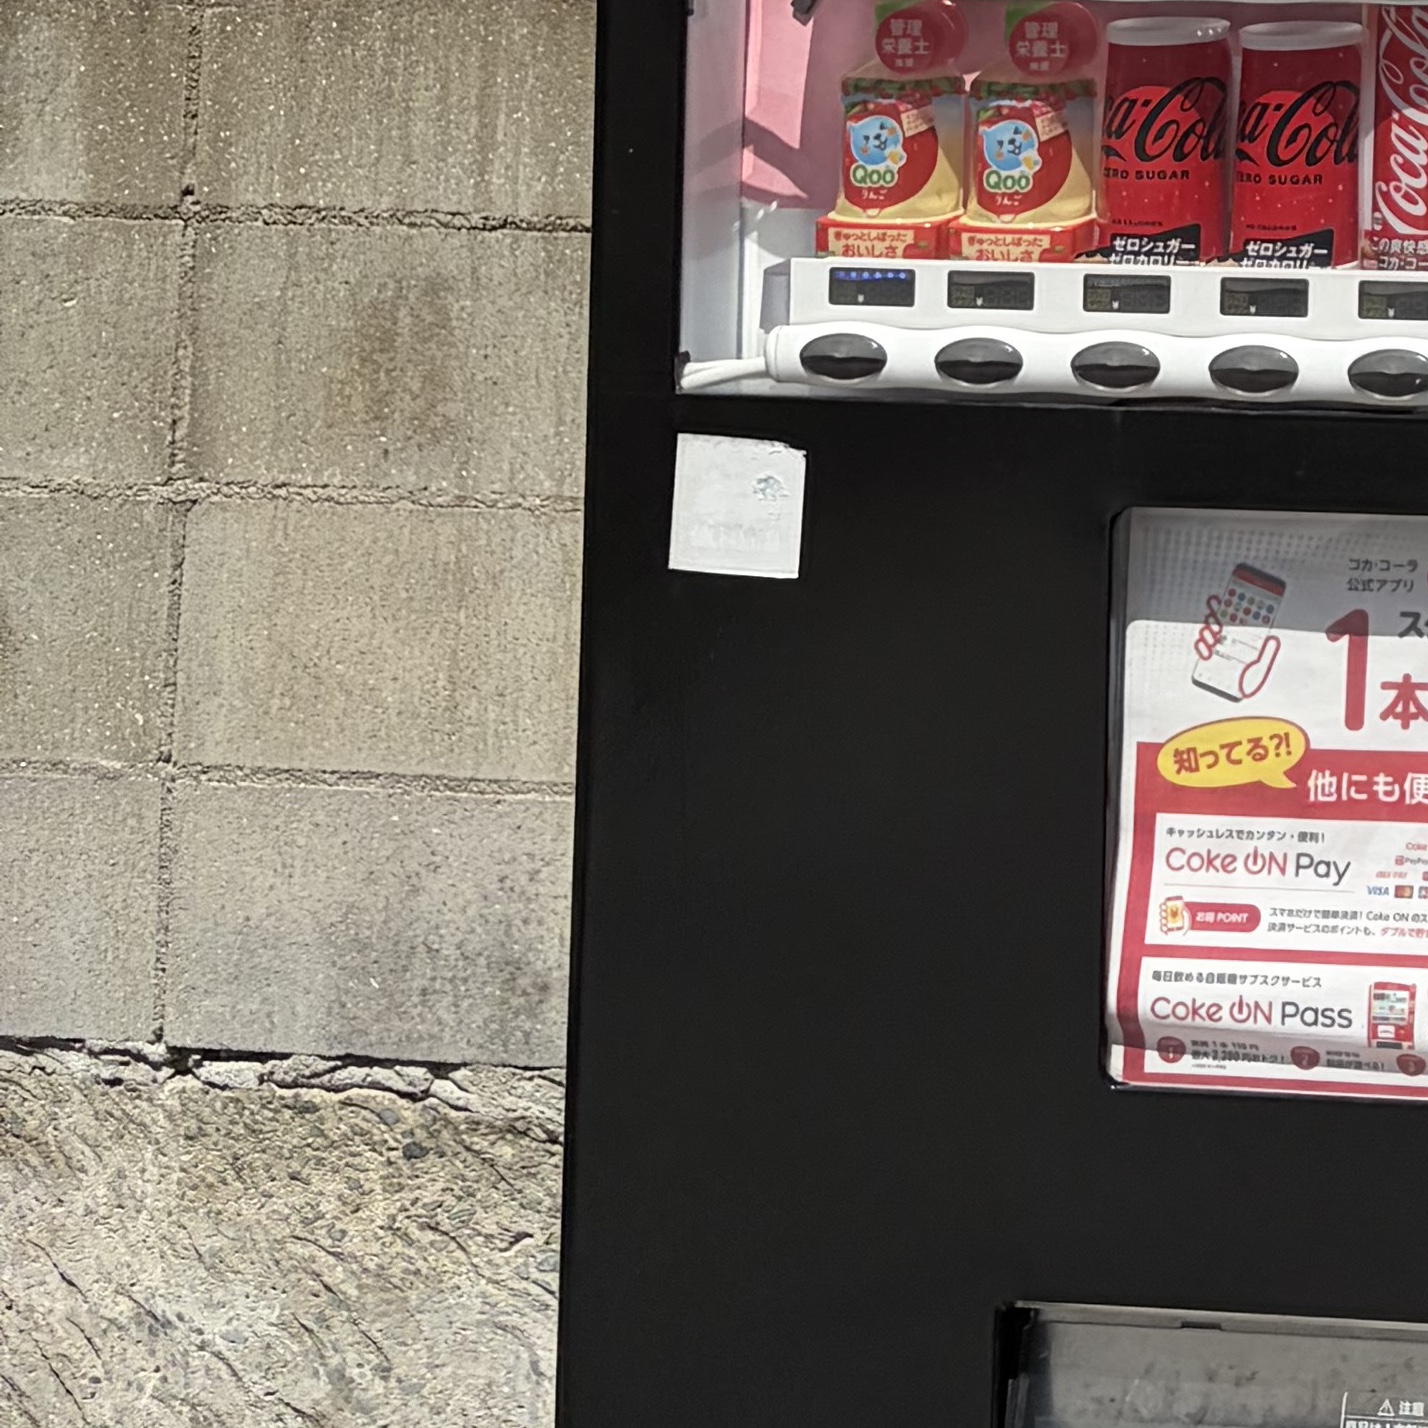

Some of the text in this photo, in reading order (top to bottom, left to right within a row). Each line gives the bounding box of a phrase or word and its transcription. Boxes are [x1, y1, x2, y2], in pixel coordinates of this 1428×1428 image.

[851, 166, 896, 186] Qoo
[985, 169, 1031, 190] Qoo
[861, 189, 889, 201] りんご
[832, 230, 915, 244] ぎゅっとしぼった
[967, 234, 1044, 247] ぎゅっとしぼった
[1112, 235, 1197, 253] ゼロシュガー
[841, 244, 899, 258] おいしさ
[1245, 240, 1329, 257] ゼロシュガー
[1347, 558, 1418, 573] コカ・コーラ
[1346, 577, 1415, 593] 公式アプリ
[1172, 732, 1292, 776] 知ってる?!
[1165, 827, 1326, 844] キャッシュレスでカンタン・便利!
[1165, 845, 1352, 886] Coke ON Pay
[1150, 994, 1354, 1029] Coke ON Pass
